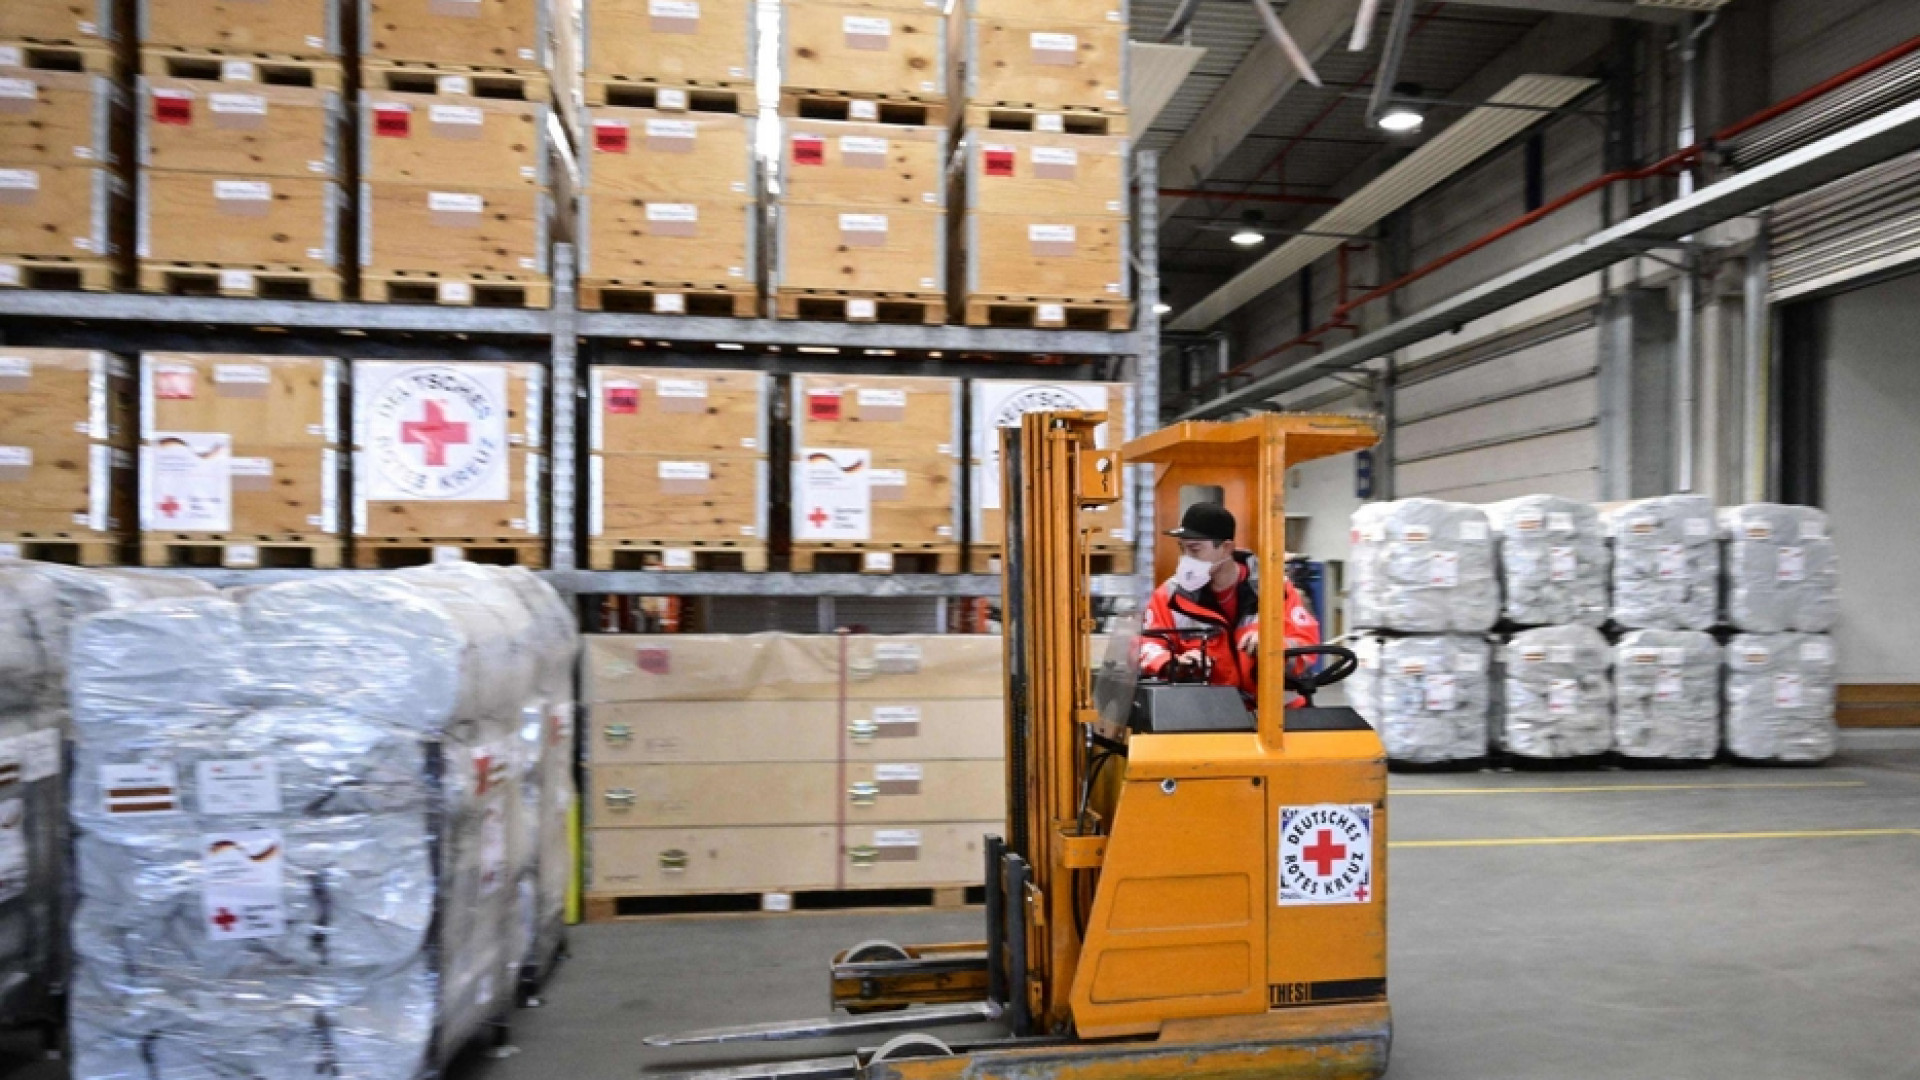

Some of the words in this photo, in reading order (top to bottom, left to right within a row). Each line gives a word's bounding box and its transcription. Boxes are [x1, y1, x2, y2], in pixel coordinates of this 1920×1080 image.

[376, 373, 492, 420] DEUTSCHES
[993, 393, 1077, 430] DEUTSCH
[1287, 810, 1362, 845] DEUTSCHES
[1285, 853, 1319, 896] ROTES
[1324, 852, 1364, 896] KREUZ
